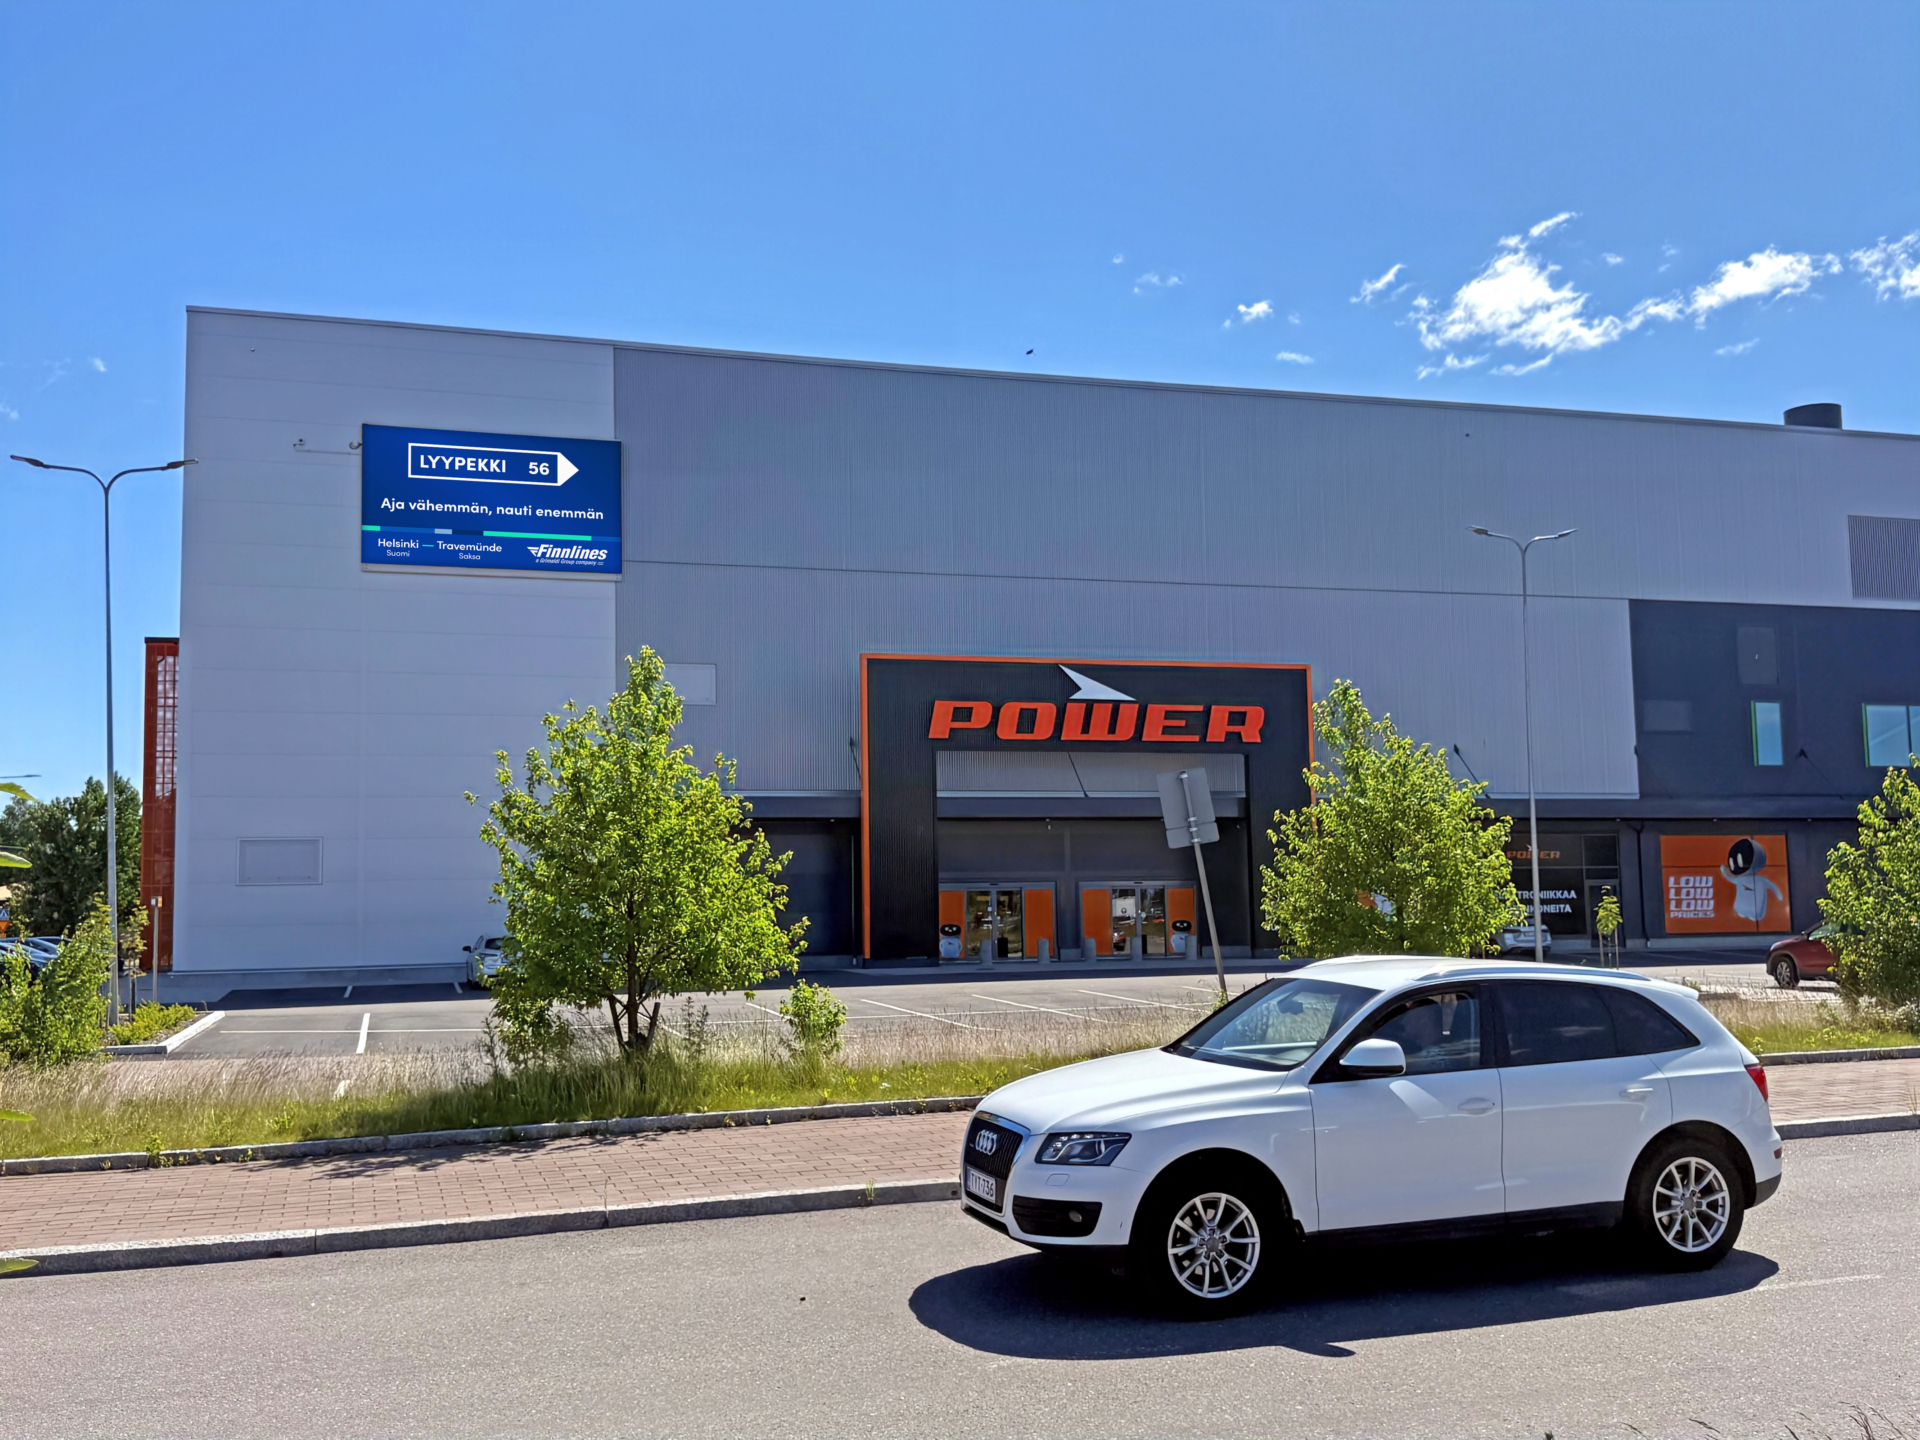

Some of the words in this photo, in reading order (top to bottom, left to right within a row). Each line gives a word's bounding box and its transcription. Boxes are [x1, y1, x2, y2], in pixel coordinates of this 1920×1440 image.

[420, 454, 506, 473] LYYPEKKI
[528, 462, 550, 475] 56
[380, 497, 405, 512] Aja
[408, 499, 493, 516] vähemmän,
[496, 505, 532, 516] nauti
[535, 508, 604, 520] enemmän
[377, 538, 419, 549] Helsinki
[436, 540, 503, 552] Travemünde
[386, 549, 411, 557] Suomi
[458, 552, 481, 560] Saksa
[536, 543, 608, 560] Finnlines
[928, 700, 1265, 743] POWER
[1668, 876, 1713, 888] LOW
[1669, 888, 1714, 899] LOW
[1670, 899, 1715, 911] LOW
[1670, 911, 1715, 919] PRICES
